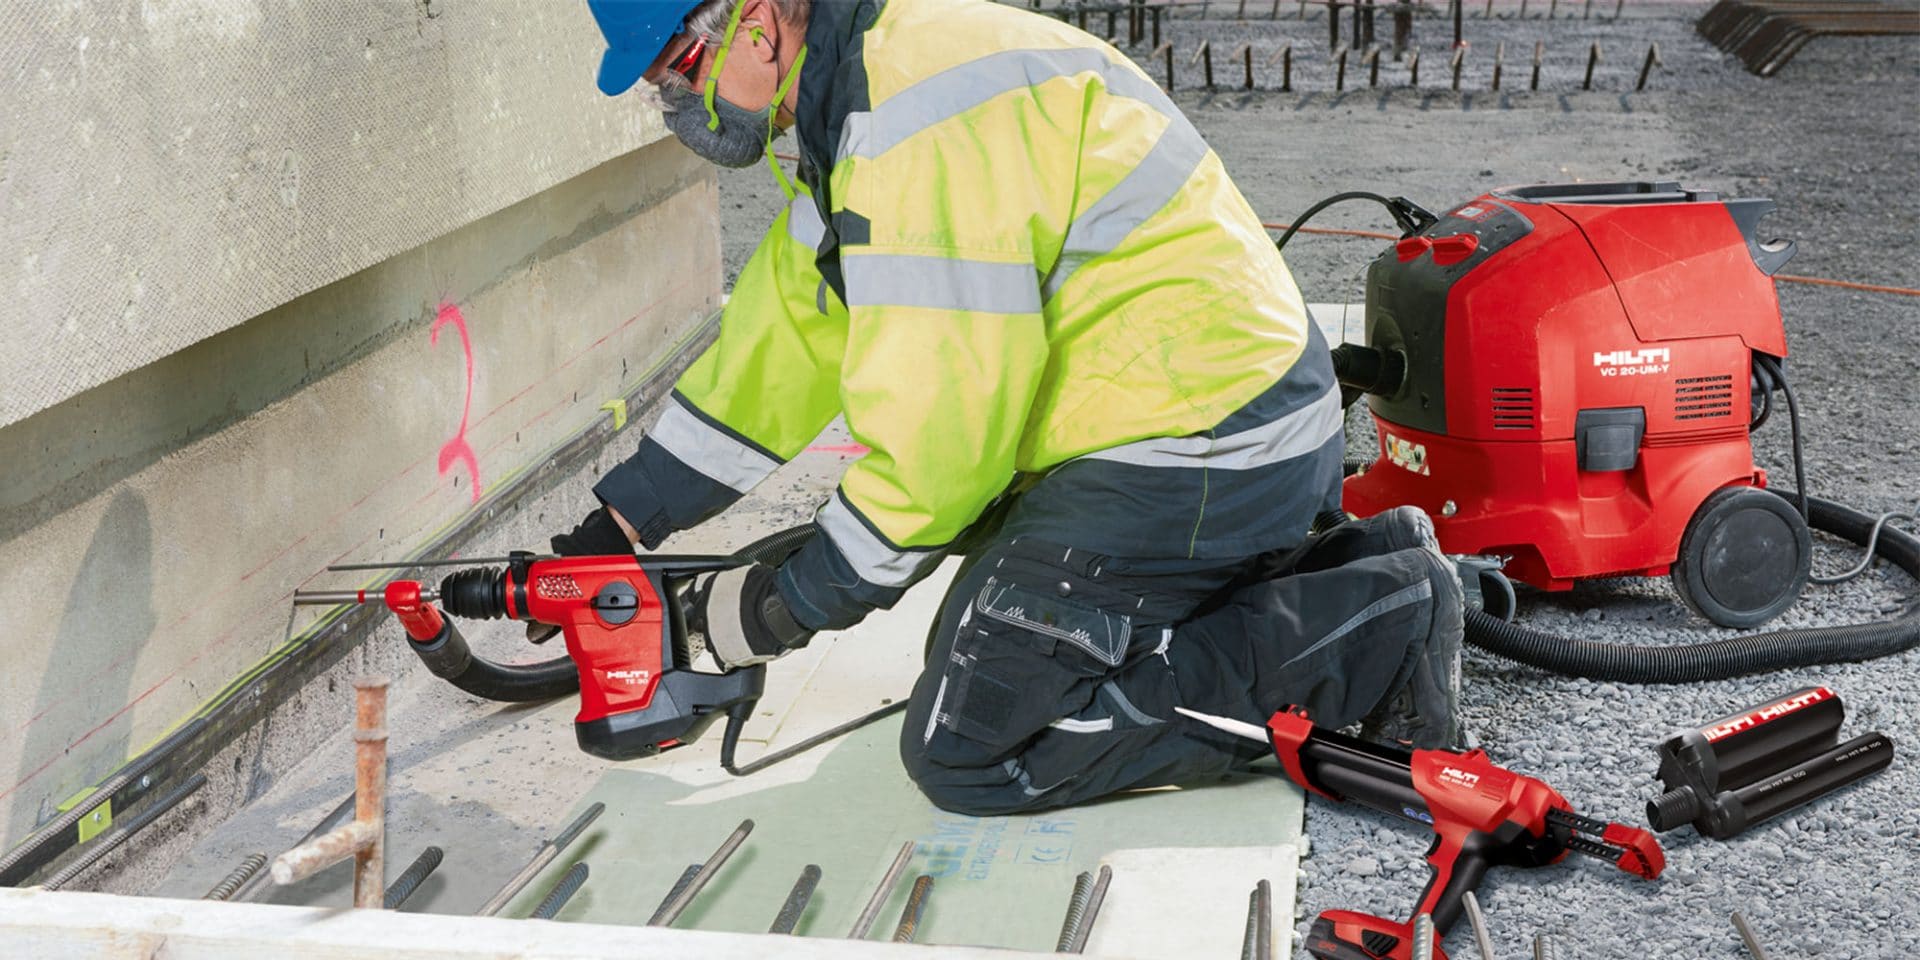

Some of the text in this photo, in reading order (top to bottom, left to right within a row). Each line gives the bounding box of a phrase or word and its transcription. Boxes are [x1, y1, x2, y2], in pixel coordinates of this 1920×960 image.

[1593, 347, 1670, 367] HILTI
[1600, 364, 1670, 377] VC 20-UM-Y
[607, 670, 649, 680] HILTI
[1757, 690, 1823, 720] HILTI
[1441, 766, 1480, 784] HILTI
